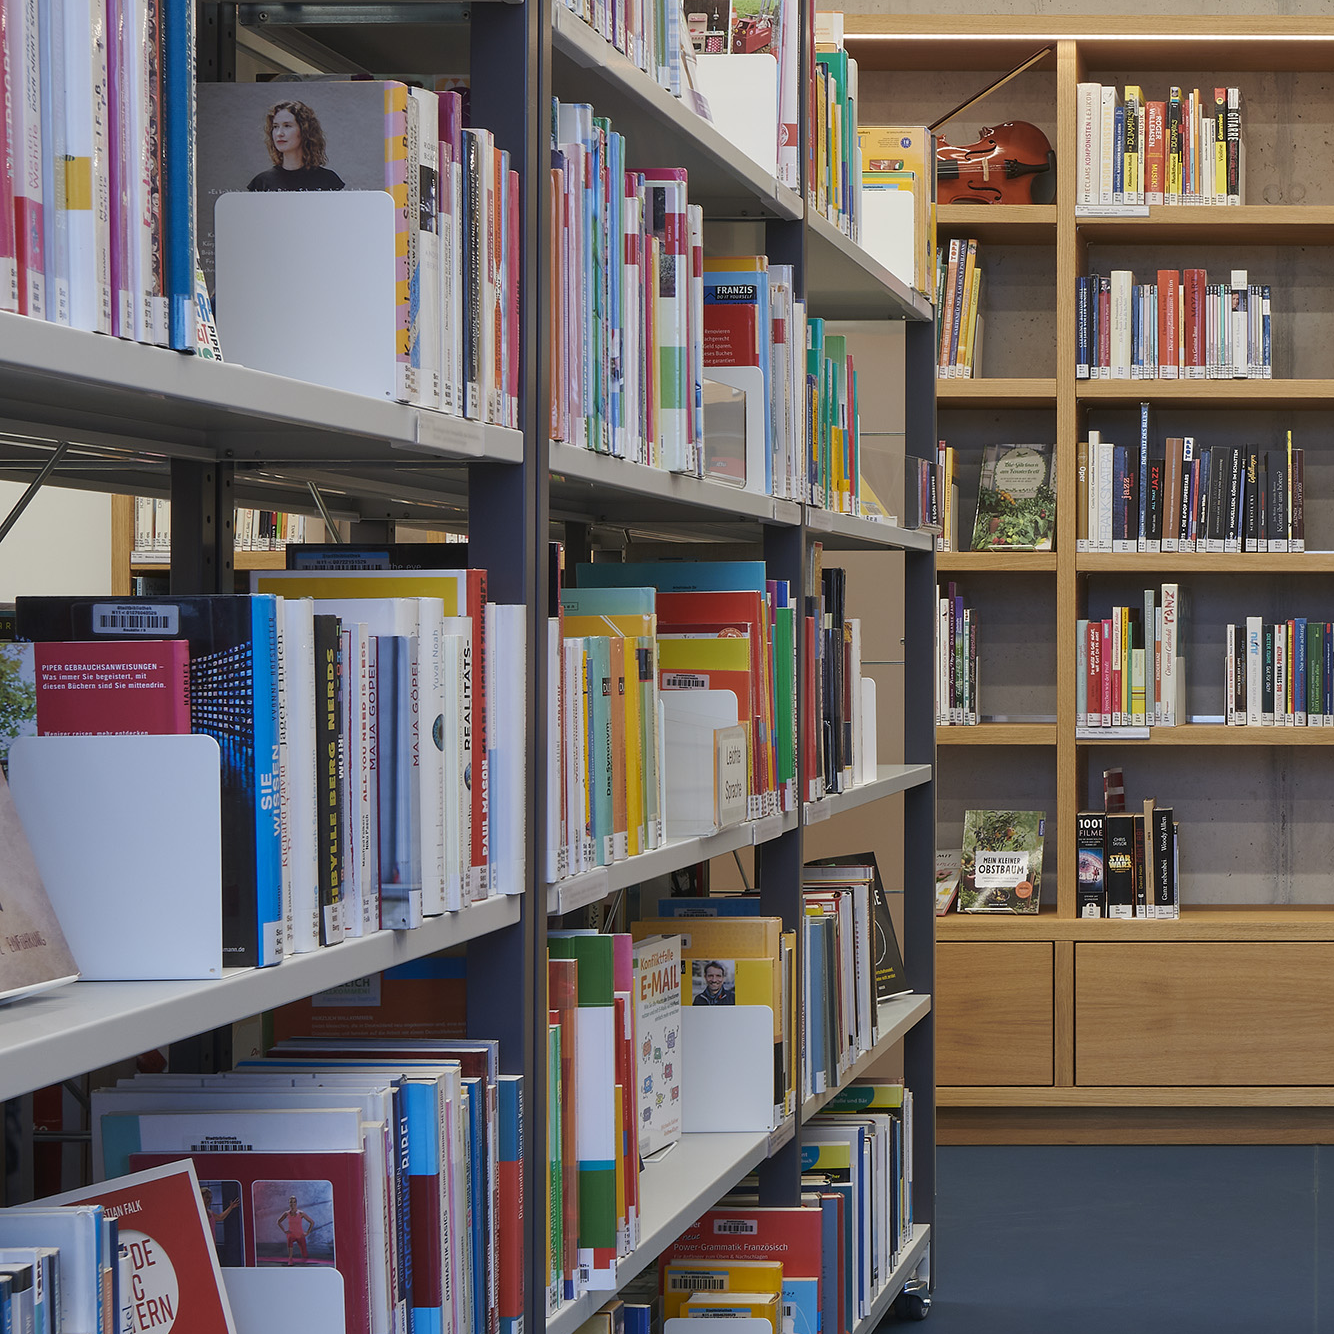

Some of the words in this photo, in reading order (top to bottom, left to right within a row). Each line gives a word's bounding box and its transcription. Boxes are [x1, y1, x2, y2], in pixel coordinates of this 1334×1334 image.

[1228, 113, 1239, 141] GITARRE
[716, 285, 753, 294] FRANZIS
[209, 325, 222, 362] PIPER
[1151, 467, 1159, 489] JAZZ
[42, 672, 57, 680] Was
[60, 672, 80, 681] immer
[83, 672, 93, 681] Sie
[96, 672, 133, 682] begeistert,
[136, 672, 146, 680] mit
[66, 663, 157, 671] GEBRAUCHSANWEISUNGEN
[43, 682, 65, 691] diesen
[68, 681, 95, 691] Büchern
[98, 681, 111, 690] sind
[114, 681, 124, 690] Sie
[127, 681, 166, 690] mittendrin.
[327, 648, 335, 729] NERDS
[411, 658, 420, 717] GÖPEL
[412, 720, 420, 769] MAJA
[328, 742, 336, 807] BERG
[260, 772, 273, 812] SIE
[271, 744, 282, 837] WISSEN
[1079, 819, 1102, 829] 1001
[979, 864, 1024, 874] OBSTBAUM
[640, 950, 674, 971] Konfliktfälle
[640, 971, 680, 1002] E-MAIL
[674, 1242, 741, 1252] Power-Grammatik
[743, 1242, 788, 1252] Französisch
